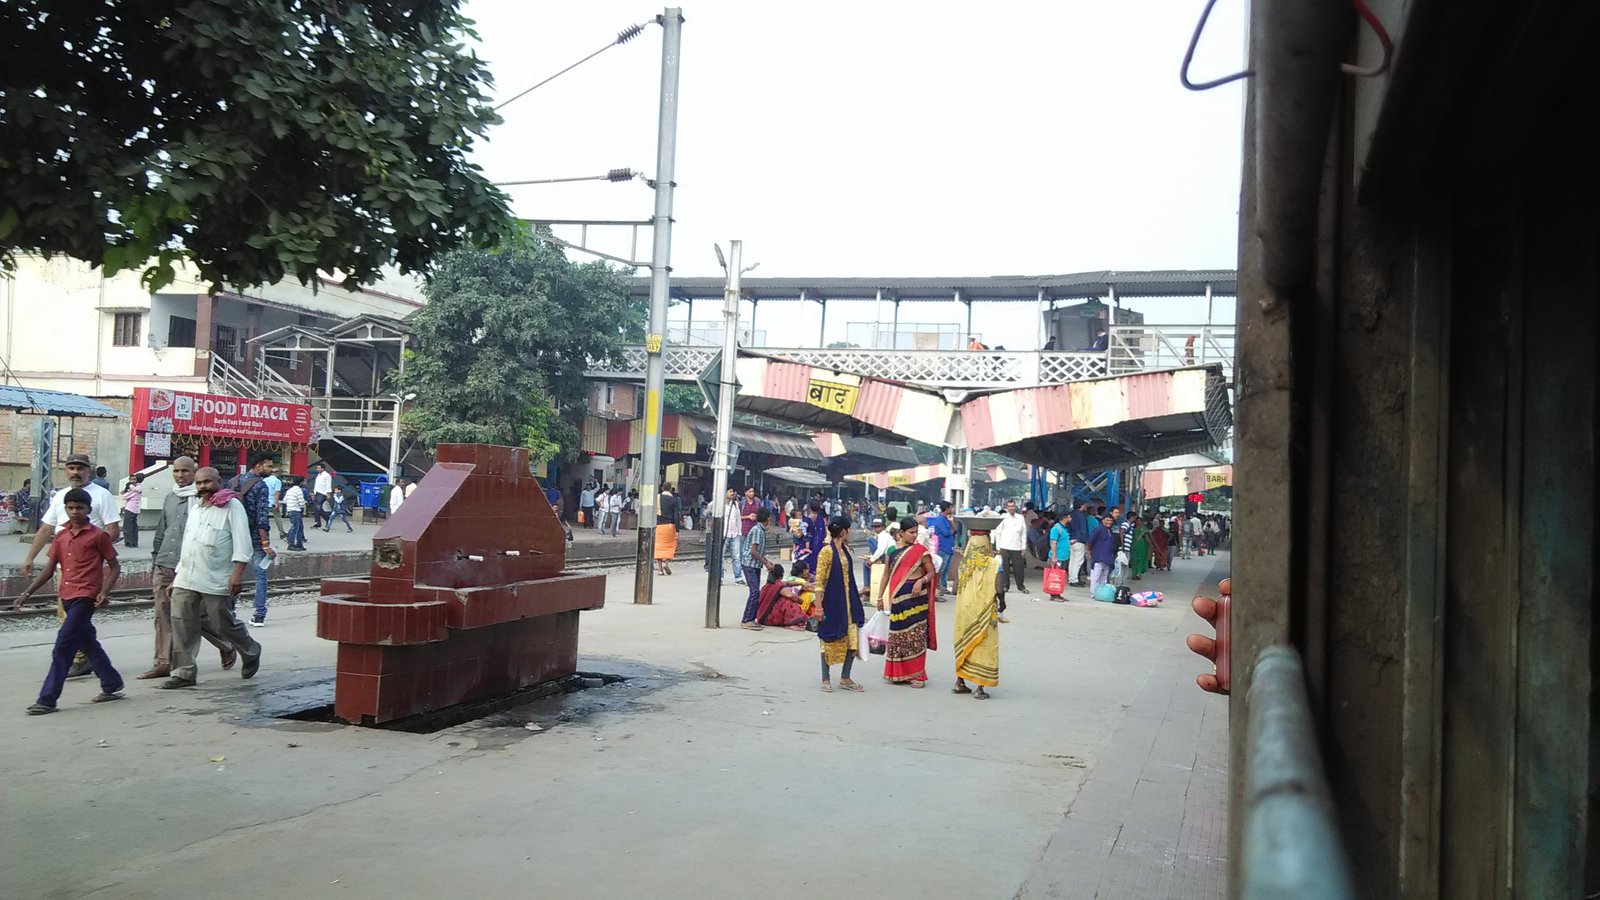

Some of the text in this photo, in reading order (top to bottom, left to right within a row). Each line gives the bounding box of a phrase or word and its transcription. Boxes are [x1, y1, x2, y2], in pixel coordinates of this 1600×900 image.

[809, 383, 851, 409] बाढ़
[193, 398, 289, 421] FOOD TRACK
[227, 418, 238, 426] Fast
[239, 419, 251, 427] Food
[252, 420, 263, 428] Unit
[1206, 474, 1226, 483] BARH
